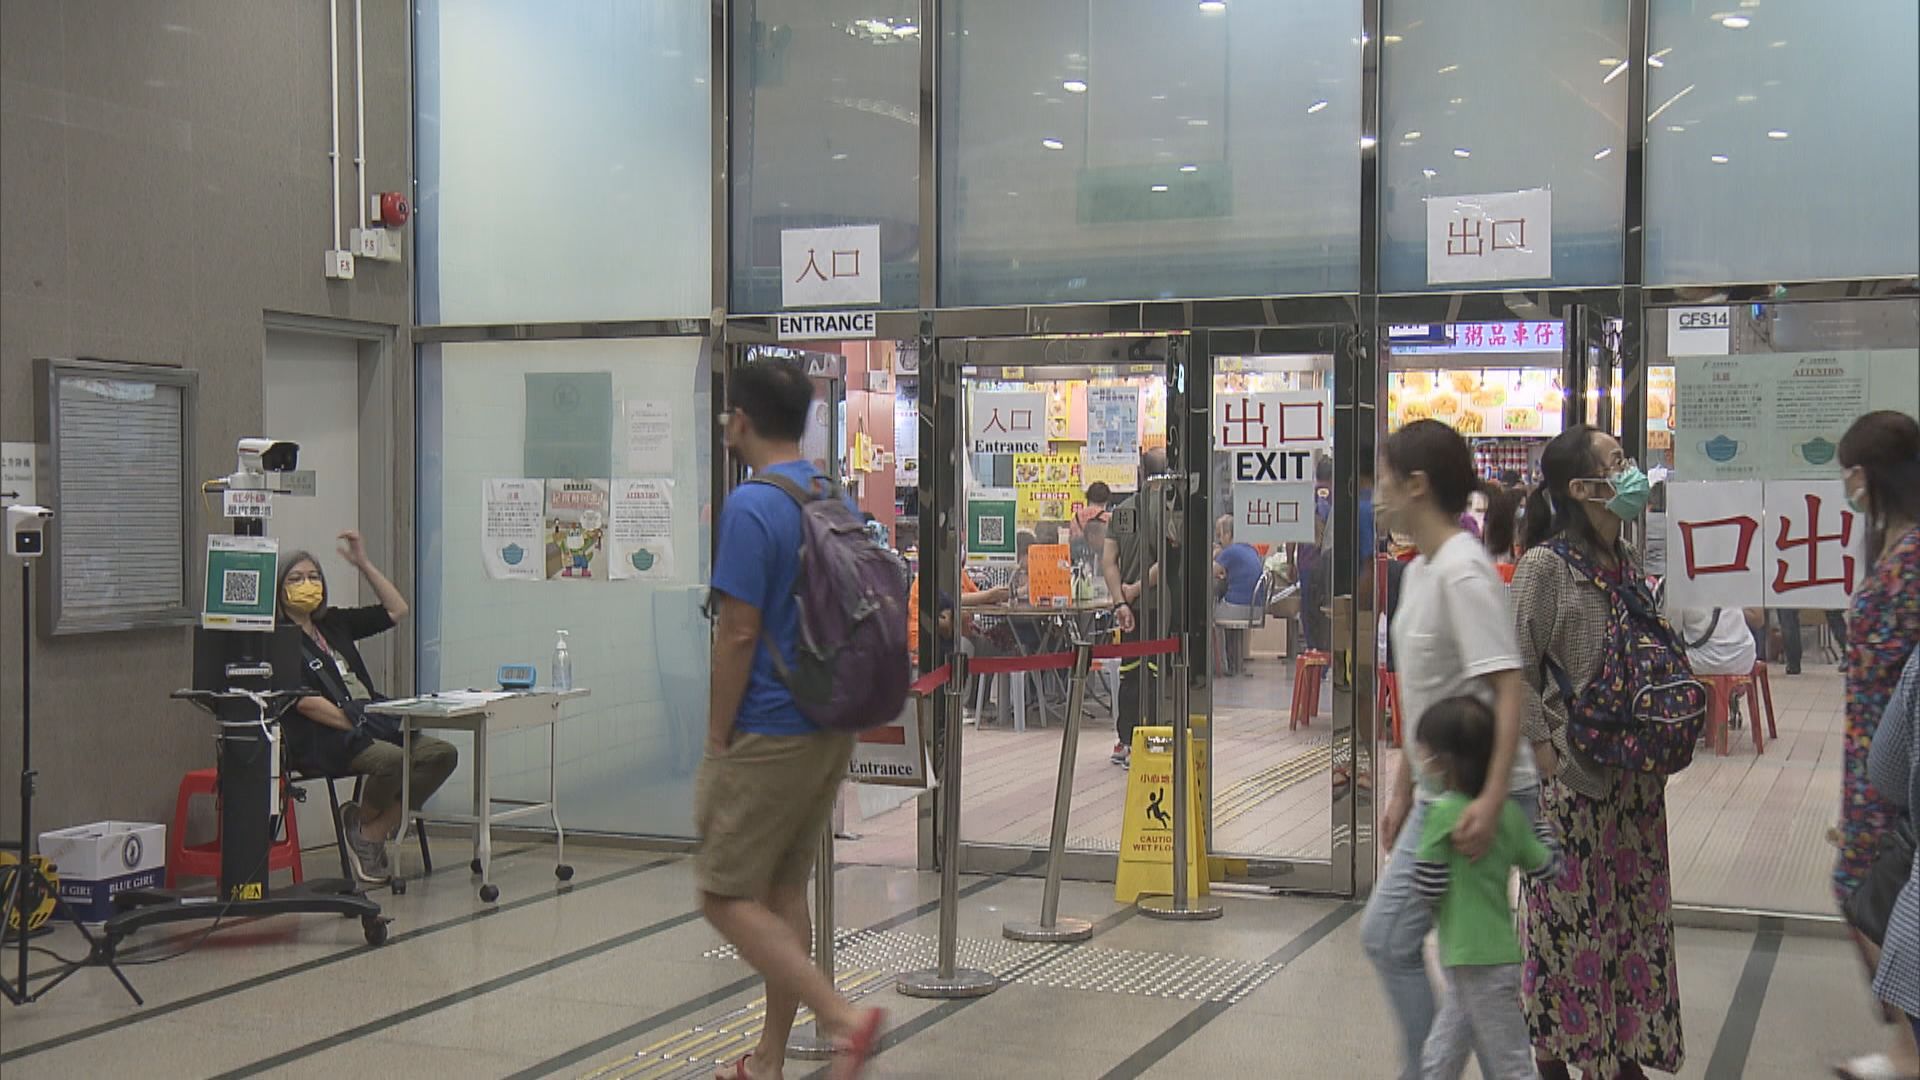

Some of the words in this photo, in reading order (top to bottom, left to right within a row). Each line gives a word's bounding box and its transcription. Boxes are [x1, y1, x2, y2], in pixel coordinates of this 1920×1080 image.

[1447, 217, 1526, 257] 出口
[795, 247, 860, 284] 入口
[780, 313, 873, 334] ENTRANCE
[1679, 311, 1729, 327] CFS14
[1455, 323, 1563, 347] 粥品車仔
[983, 407, 1032, 433] 入口
[1222, 398, 1324, 448] 出口
[974, 439, 1039, 454] Entrance
[1236, 452, 1310, 481] EXIT
[1247, 498, 1299, 526] 出口
[849, 760, 913, 775] Entrance
[1140, 774, 1170, 784] 小心地
[1140, 836, 1172, 844] CAUTIO
[109, 880, 132, 893] BLUE
